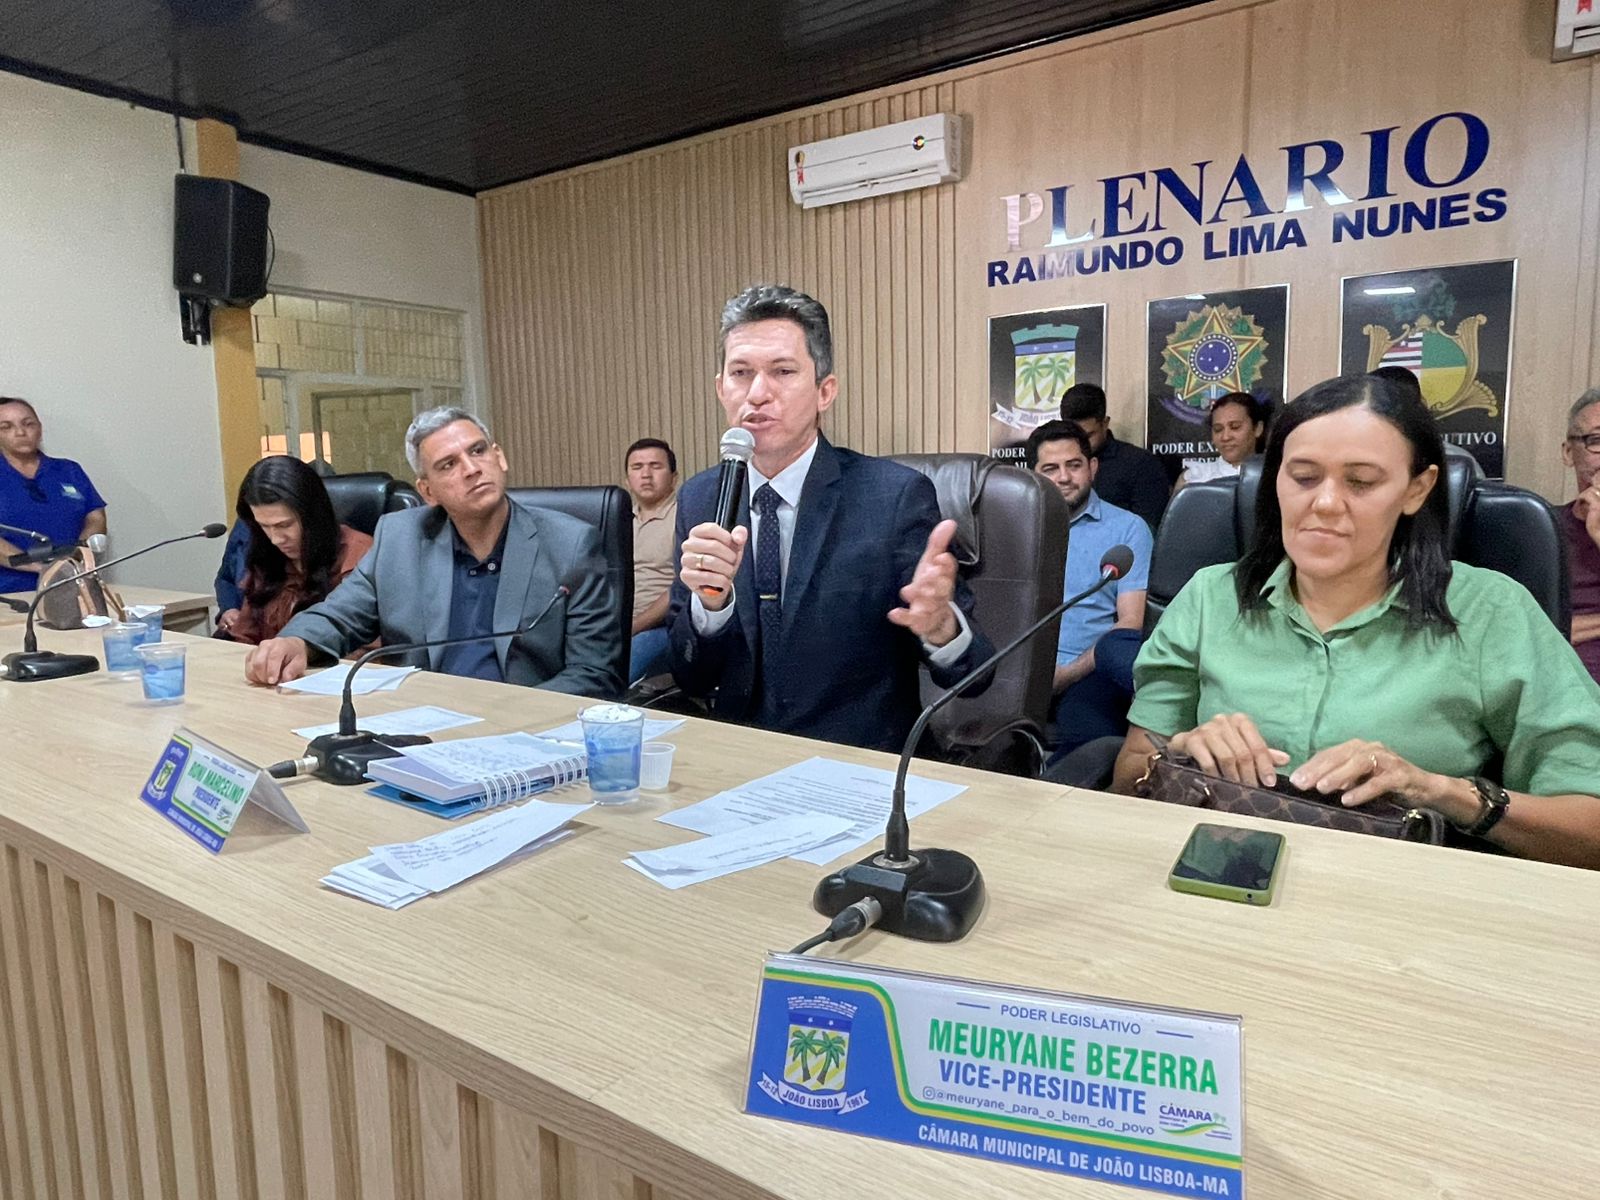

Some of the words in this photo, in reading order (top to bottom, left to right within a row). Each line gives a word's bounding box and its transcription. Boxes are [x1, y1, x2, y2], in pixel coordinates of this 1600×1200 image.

[1000, 112, 1490, 254] PLENARIO
[987, 236, 1184, 287] RAIMUNDO
[1204, 217, 1307, 261] LIMA
[1332, 188, 1508, 243] NUNES
[991, 447, 1026, 458] PODER
[1152, 442, 1195, 454] PODER
[202, 769, 245, 804] MARCELINO
[1001, 1005, 1047, 1022] PODER
[1051, 1011, 1141, 1035] LEGISLATIVO
[928, 1018, 1075, 1073] MEURYANE
[1086, 1040, 1218, 1095] BEZERRA
[782, 1089, 806, 1105] JOÃO
[807, 1097, 840, 1108] LISBOA
[939, 1059, 1146, 1115] VICE-PRESIDENTE
[918, 1123, 979, 1150] CÂMARA
[983, 1136, 1065, 1166] MUNICIPAL
[1069, 1151, 1089, 1170] DE
[1093, 1156, 1135, 1178] JOÃO
[1139, 1164, 1230, 1197] LISBOA-MA
